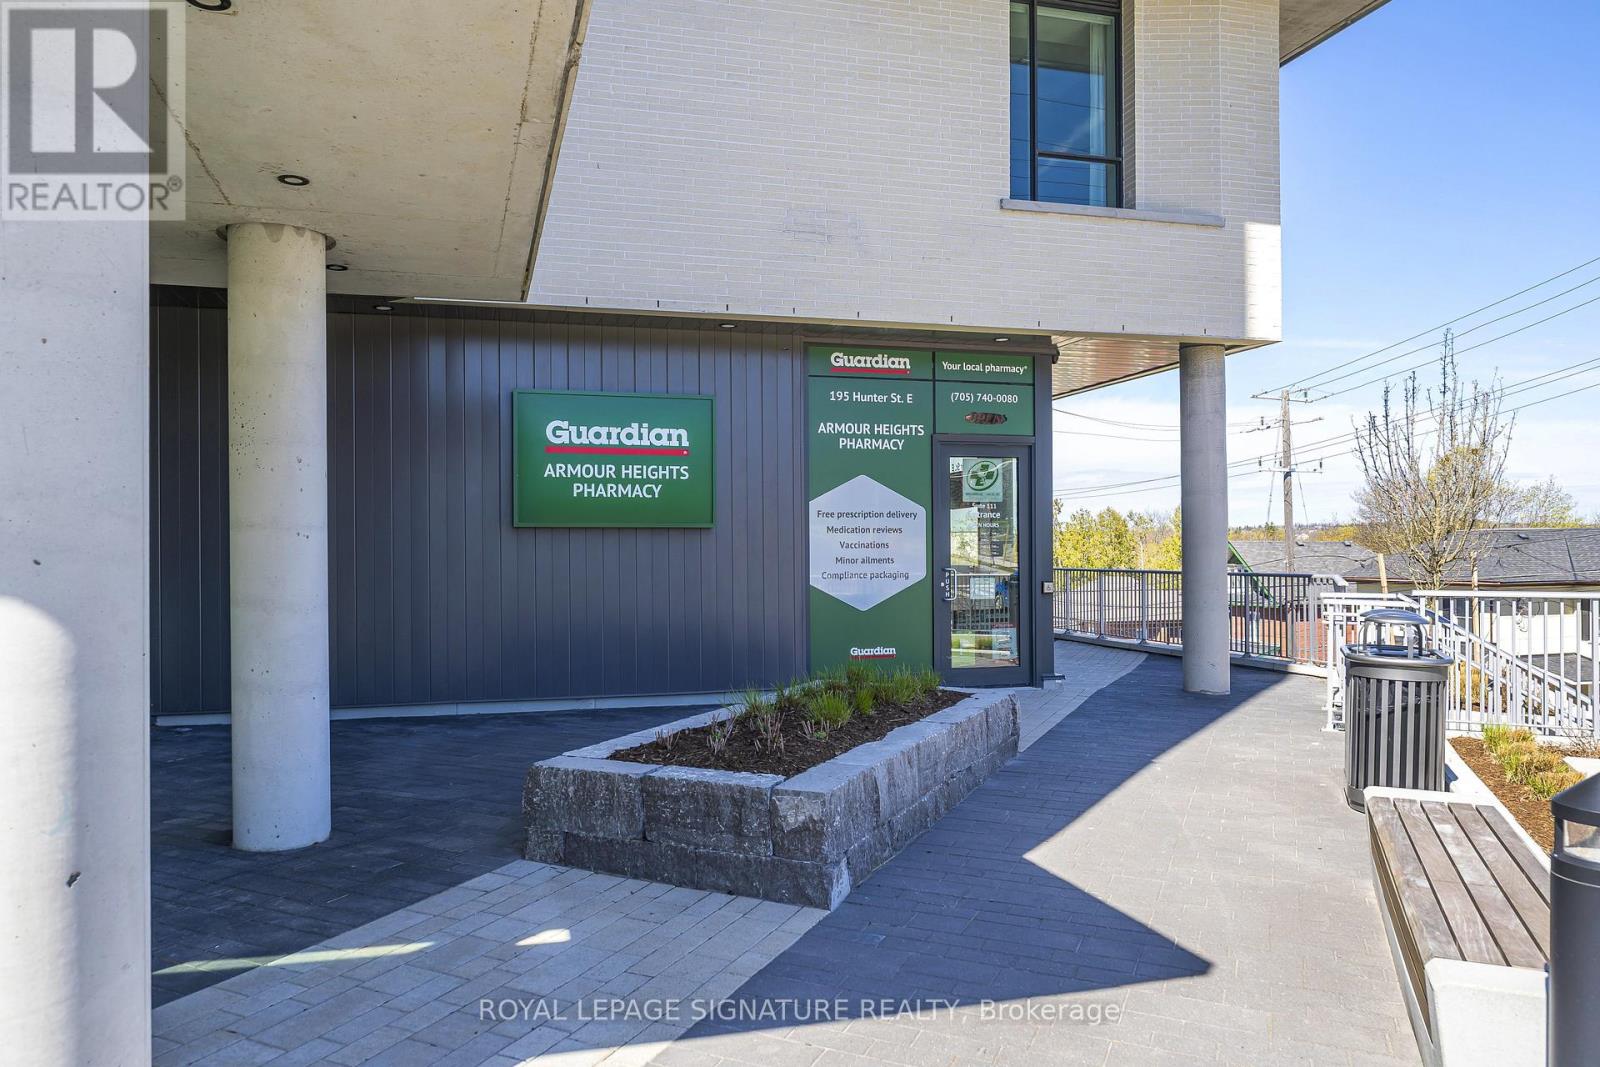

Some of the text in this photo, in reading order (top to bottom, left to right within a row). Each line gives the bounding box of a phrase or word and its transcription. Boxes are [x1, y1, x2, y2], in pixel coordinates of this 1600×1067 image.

[830, 352, 911, 369] Guardian
[942, 361, 961, 370] Your
[963, 362, 983, 372] local
[829, 390, 913, 403] 195 Hunter St. E
[950, 392, 1018, 404] (705) 740-0080
[545, 420, 690, 447] Guardian
[818, 422, 925, 436] ARMOUR HEIGHTS
[839, 438, 905, 450] PHARMACY
[544, 463, 690, 480] ARMOUR HEIGHTS
[573, 483, 663, 498] PHARMACY
[817, 510, 918, 520] Free prescription delivery
[826, 526, 903, 534] Medication reviews
[839, 541, 890, 549] Vaccinations
[835, 556, 895, 565] Minor ailments
[821, 571, 910, 581] Compliance packaging
[850, 646, 897, 656] Guardian
